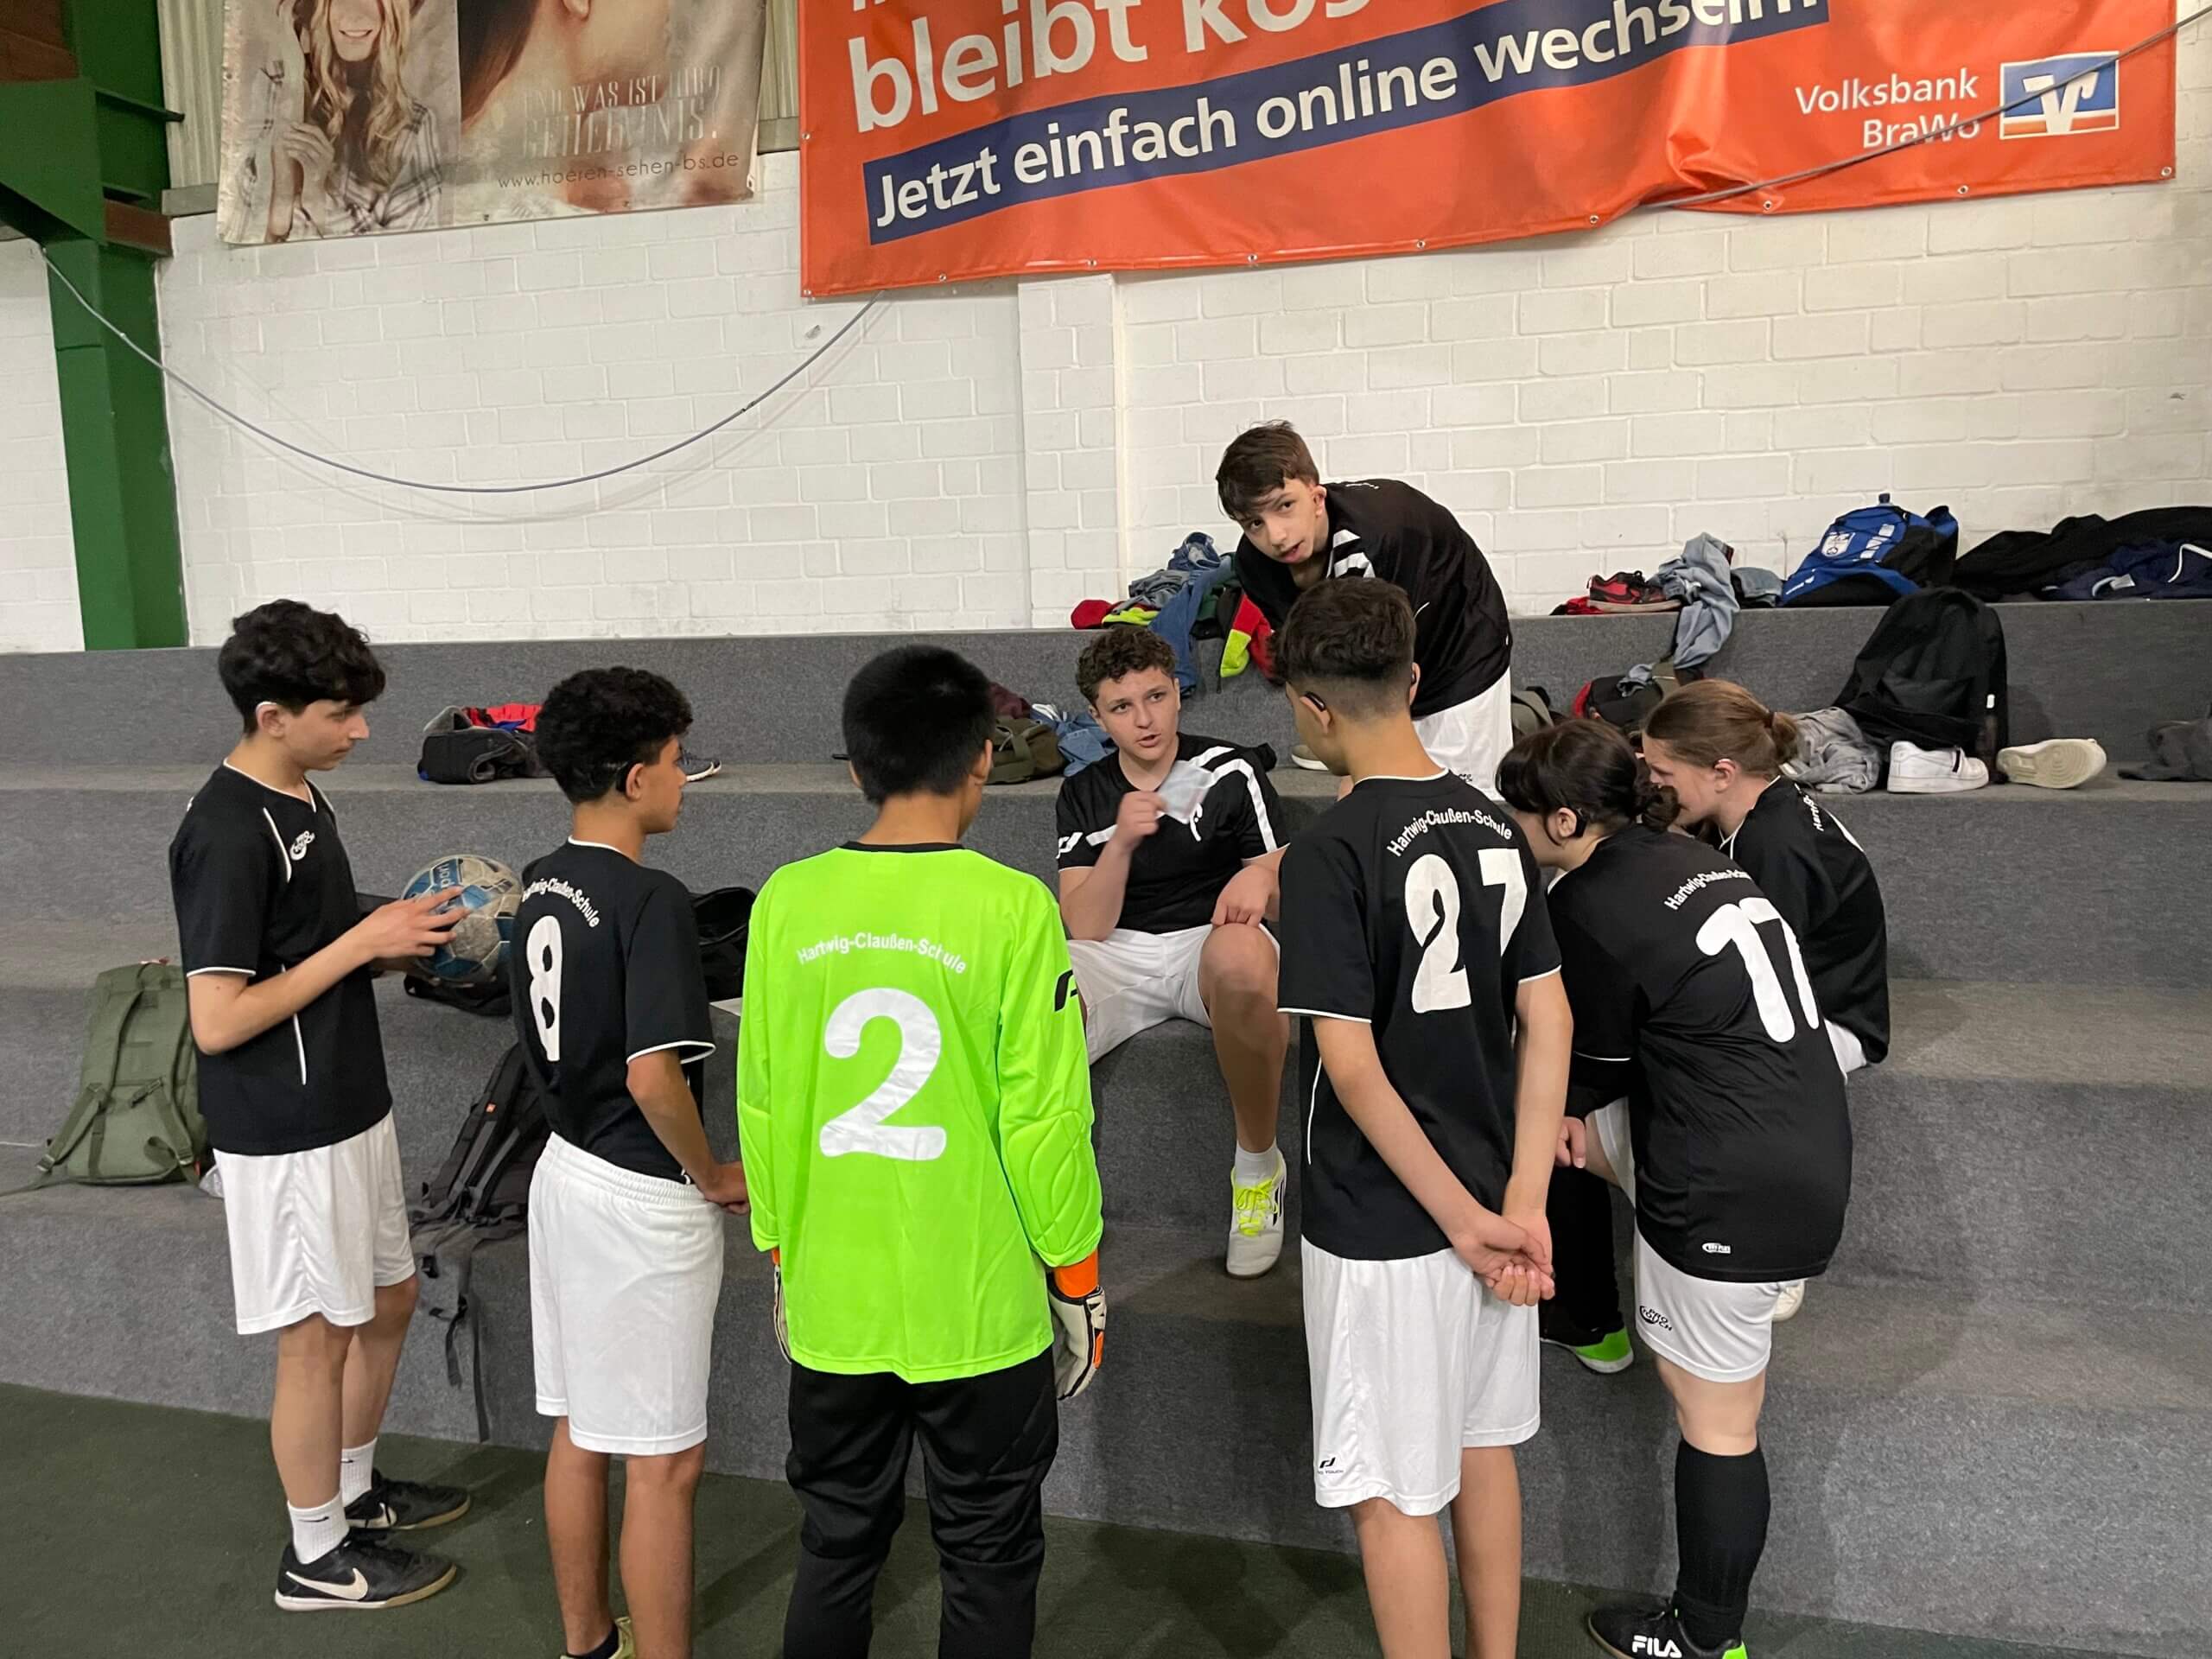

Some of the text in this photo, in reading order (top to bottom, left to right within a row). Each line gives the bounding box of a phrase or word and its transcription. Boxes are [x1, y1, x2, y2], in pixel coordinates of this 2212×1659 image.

[572, 82, 620, 111] WAS
[629, 74, 659, 105] IST
[848, 0, 1148, 133] bleibt
[1795, 67, 1979, 114] Volksbank
[499, 153, 740, 188] www.hoeren-sehen-bs.de
[876, 147, 1001, 227] Jetzt
[1014, 97, 1237, 185] einfach
[1256, 56, 1458, 139] online
[1862, 111, 1980, 149] BraWo
[1404, 848, 1528, 1014] 27
[526, 914, 563, 1062] 8
[820, 988, 947, 1160] 2
[1631, 1635, 1682, 1659] FILA
